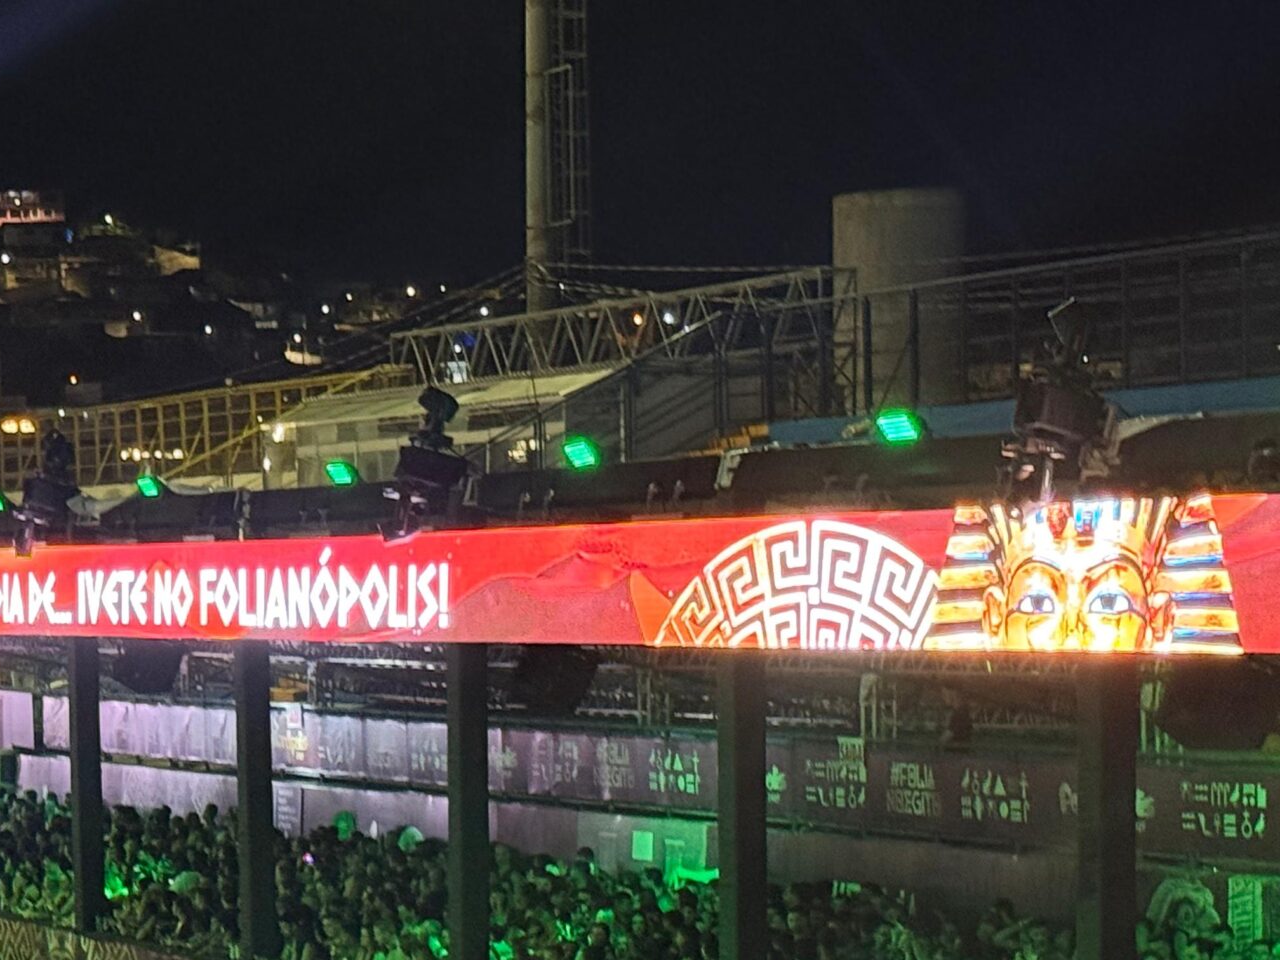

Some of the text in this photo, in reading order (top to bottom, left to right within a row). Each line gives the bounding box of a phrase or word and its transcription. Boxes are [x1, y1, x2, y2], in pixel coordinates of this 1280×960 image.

[77, 568, 148, 625] IVETE
[153, 568, 194, 626] NO
[200, 545, 450, 629] FOLIANÓPOLIS!
